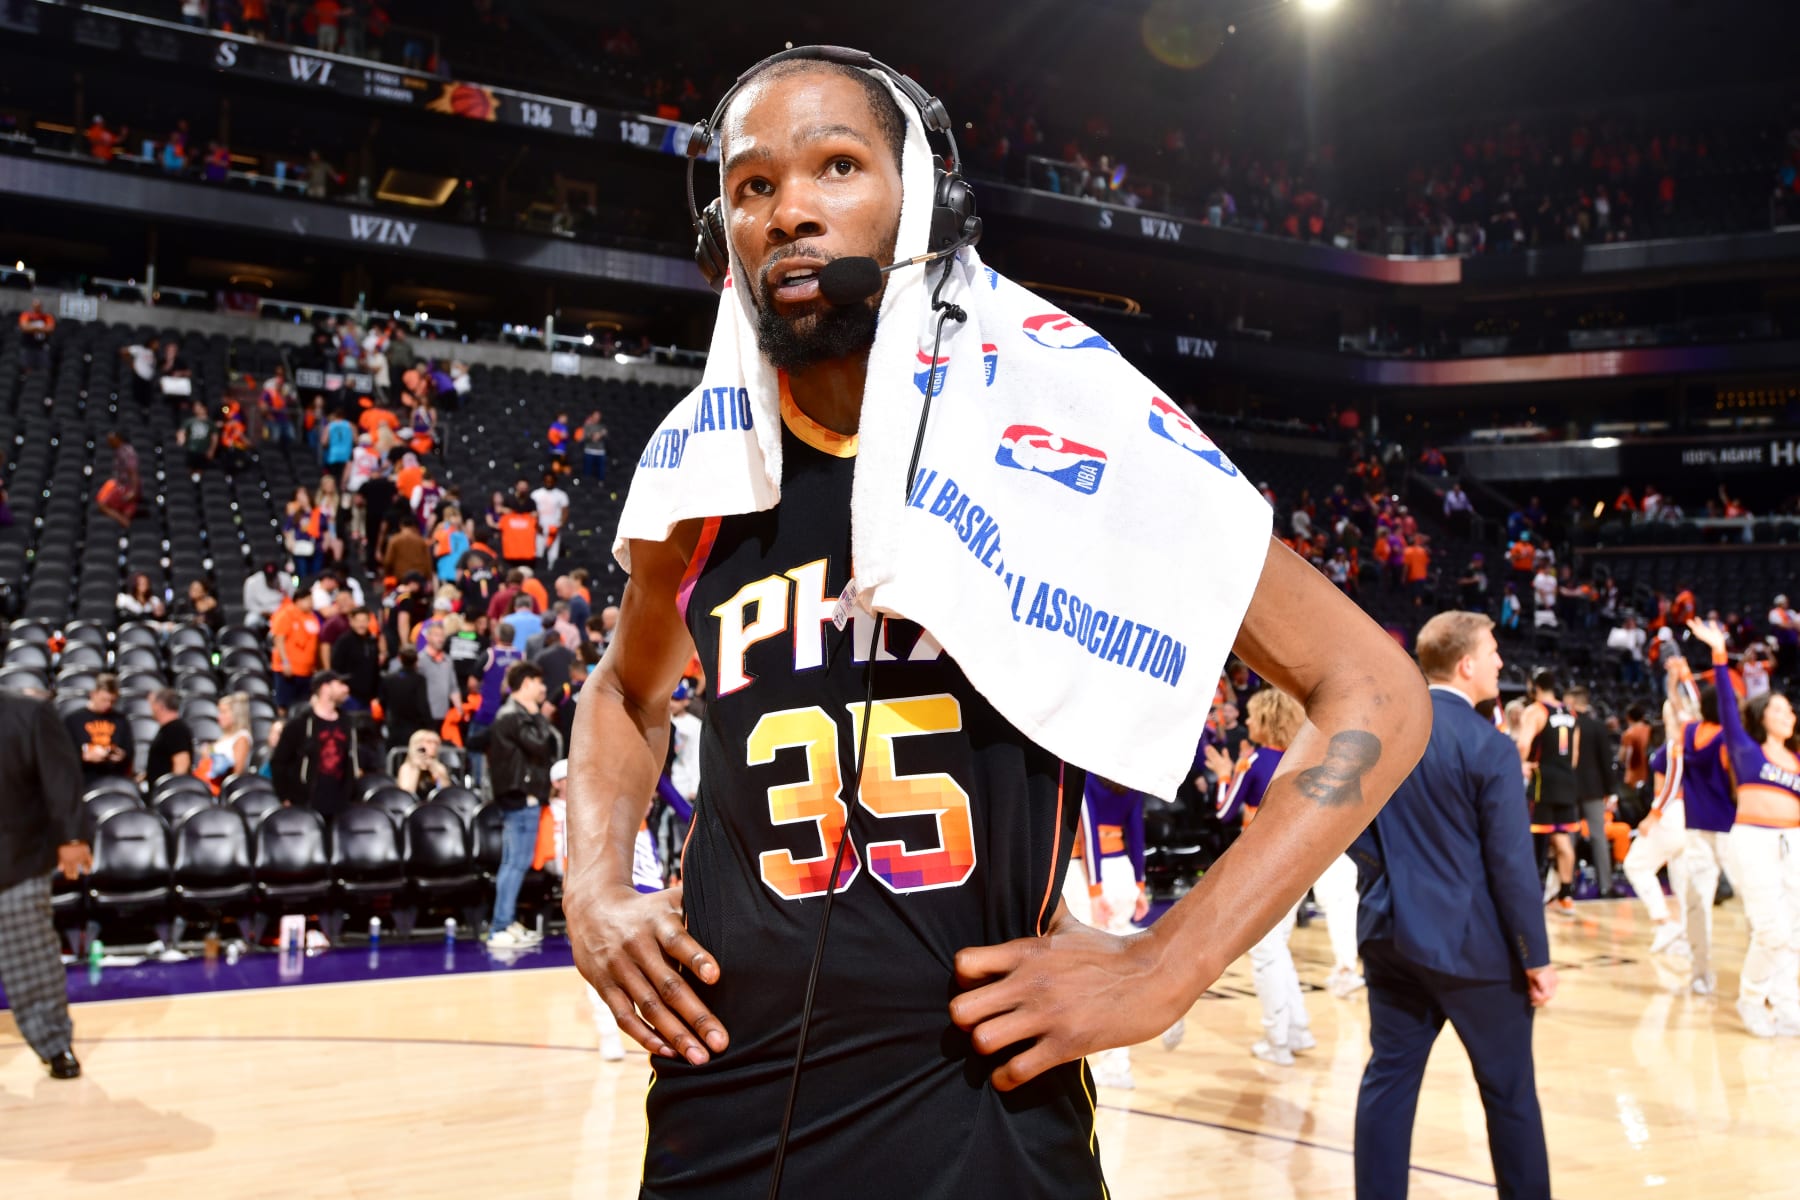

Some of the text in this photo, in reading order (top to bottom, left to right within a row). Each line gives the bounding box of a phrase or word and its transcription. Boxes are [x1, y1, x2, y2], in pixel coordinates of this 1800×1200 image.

[216, 41, 239, 67] S
[520, 102, 553, 129] 136
[349, 214, 417, 247] WIN
[1141, 216, 1183, 241] WIN
[1177, 335, 1218, 359] WIN
[1770, 441, 1800, 467] H
[1075, 464, 1098, 490] NBA
[710, 557, 945, 699] PH
[1025, 581, 1187, 688] ASSOCIATION
[746, 693, 977, 901] 35
